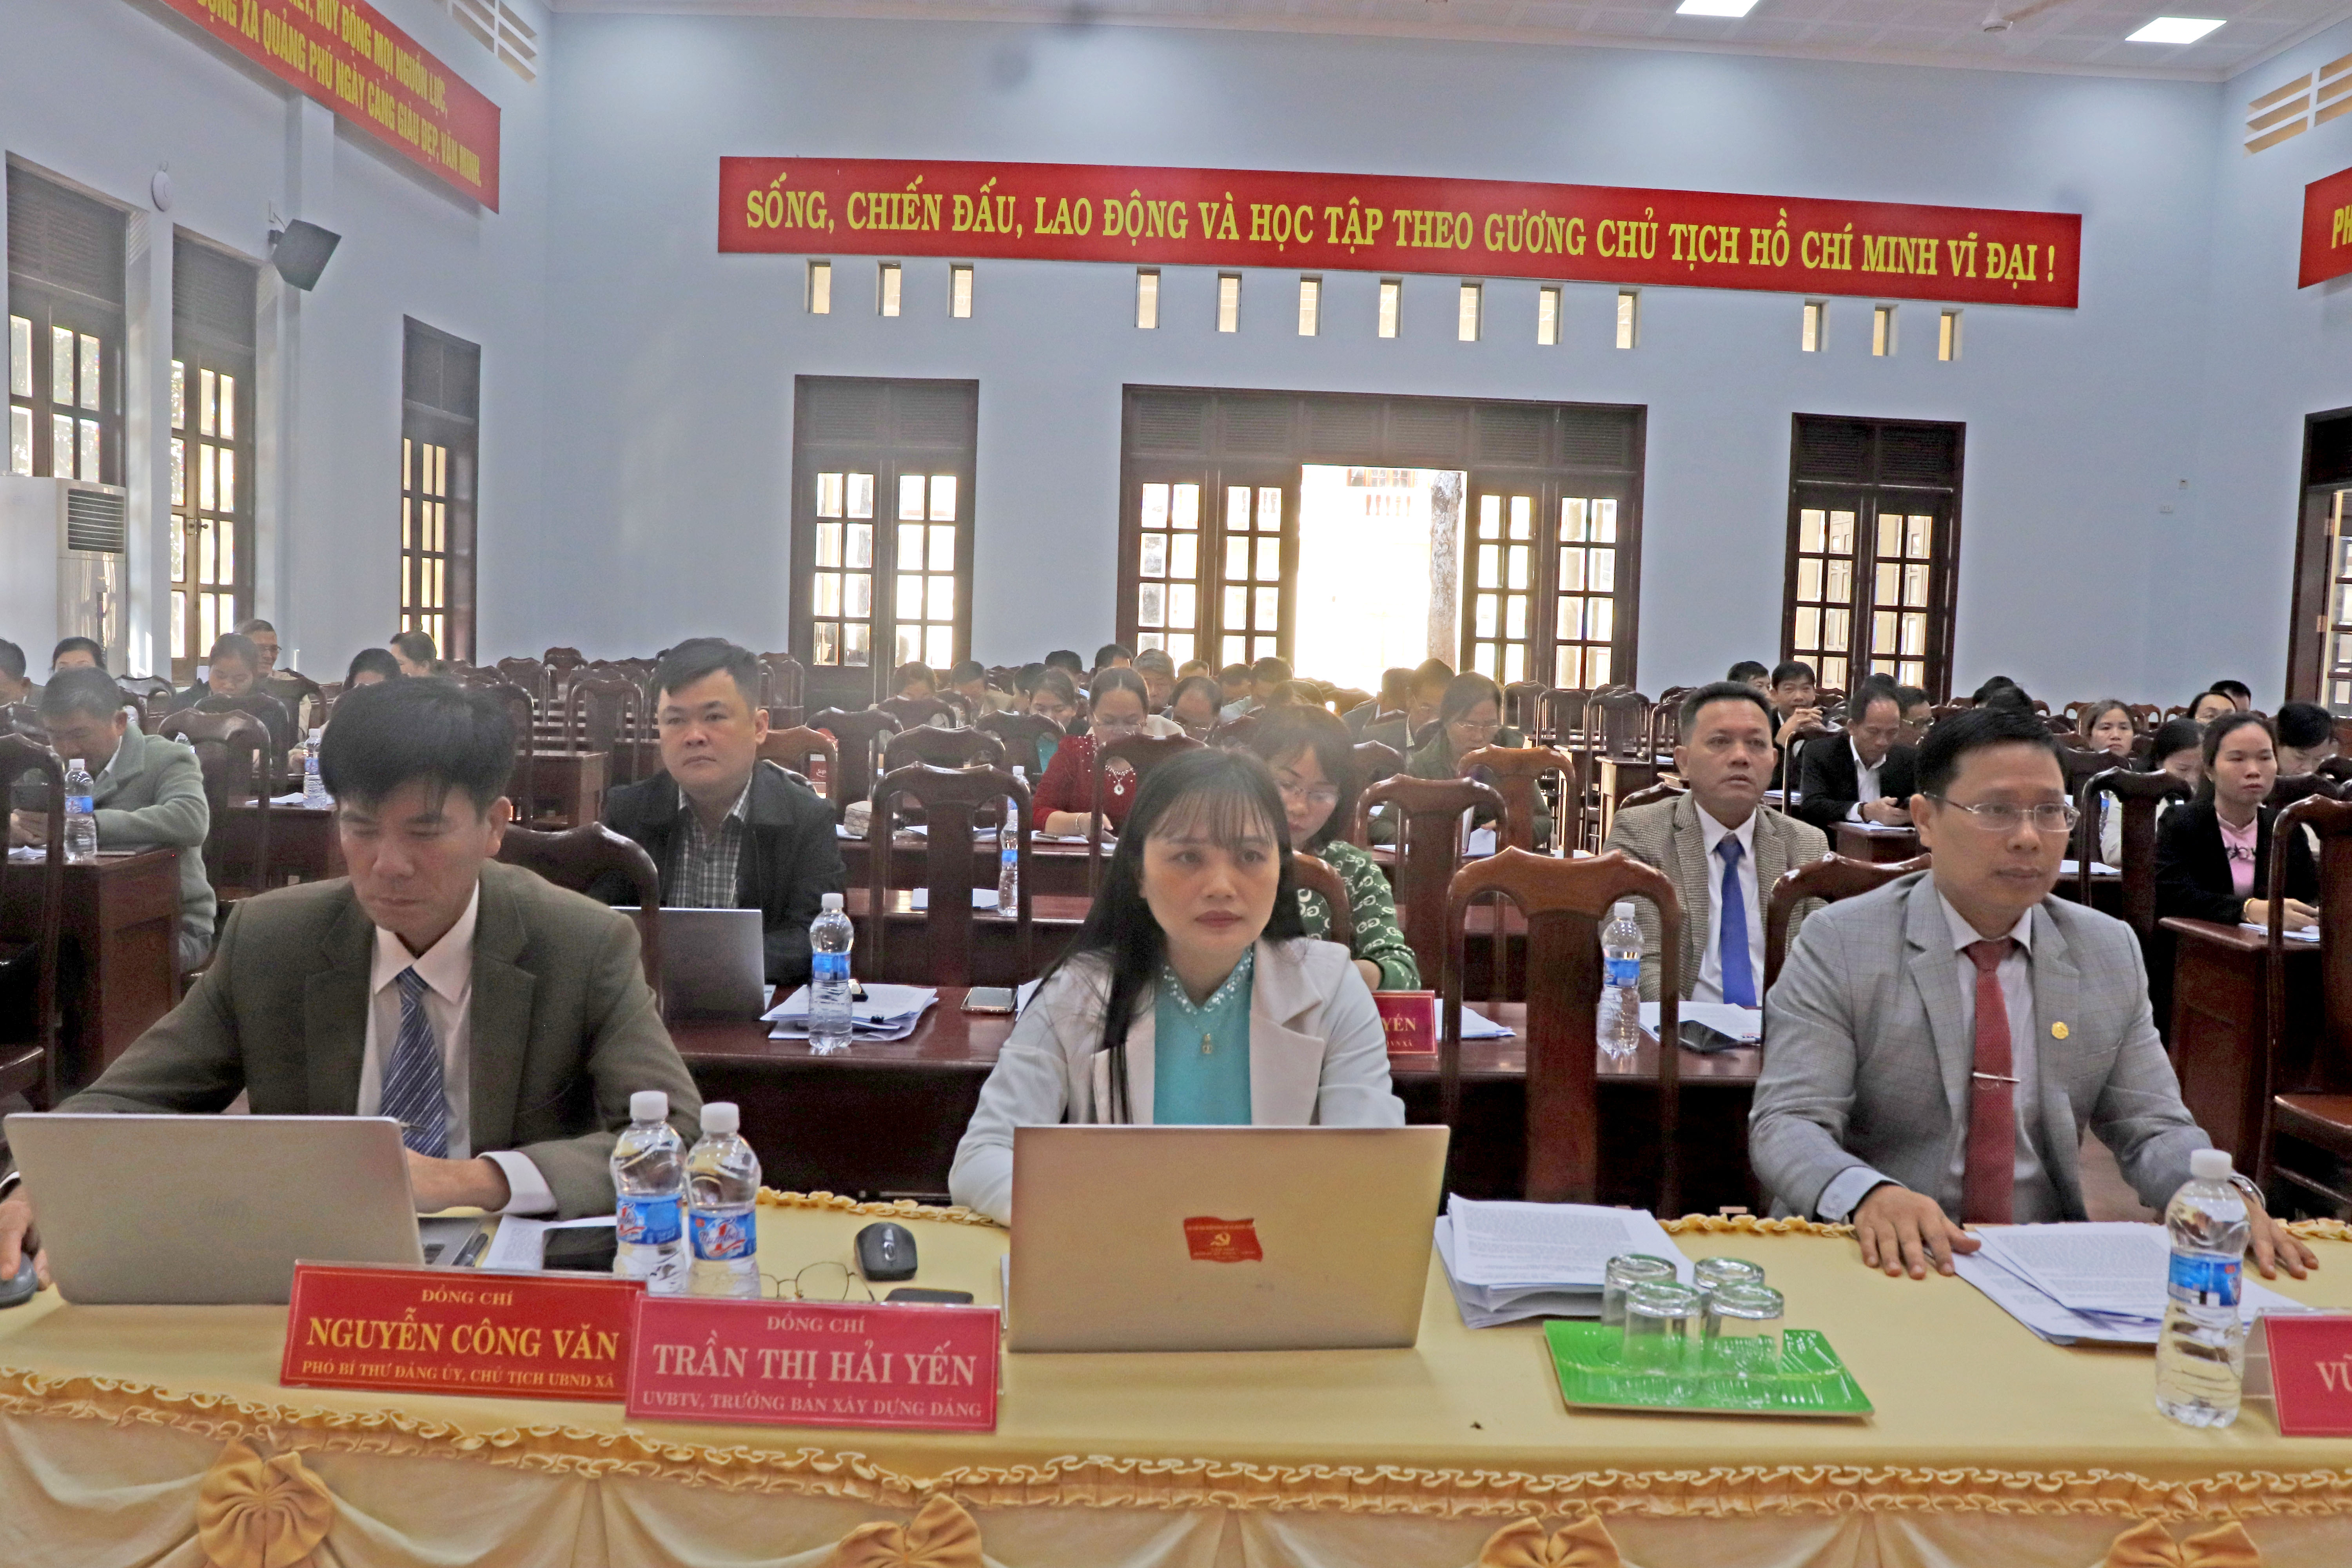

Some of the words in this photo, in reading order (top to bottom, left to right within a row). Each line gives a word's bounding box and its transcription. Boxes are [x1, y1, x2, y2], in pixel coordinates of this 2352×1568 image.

[263, 7, 306, 73] QUẢNG
[309, 40, 333, 90] PHÚ
[336, 58, 365, 111] NGÀY
[368, 77, 395, 131] CÀNG
[397, 100, 419, 147] GIÀU
[341, 4, 371, 60] ĐỘNG
[374, 29, 393, 80] MỌI
[396, 46, 427, 101] NGUỒN
[746, 172, 835, 234] SỐNG,
[847, 175, 943, 230] CHIẾN
[952, 176, 1023, 239] ĐẤU,
[1034, 197, 1093, 236] LAO
[1102, 189, 1189, 247] ĐỘNG
[1198, 191, 1240, 240] VÀ
[1249, 204, 1314, 252] HỌC
[1324, 196, 1384, 254] TẬP
[1392, 209, 1474, 250] THEO
[1485, 208, 1587, 257] GƯƠNG
[1597, 207, 1659, 260] CHỦ
[1669, 223, 1741, 271] TỊCH
[1749, 207, 1790, 267] HỒ
[1801, 223, 1853, 270] CHÍ
[1861, 235, 1939, 275] MINH
[1947, 232, 1978, 278] VĨ
[1986, 242, 2038, 289] ĐẠI
[422, 1283, 474, 1304] ĐỒNG
[479, 1290, 514, 1306] CHÍ
[306, 1307, 444, 1352] NGUYỄN
[451, 1318, 542, 1357] CÔNG
[552, 1323, 620, 1361] VĂN
[829, 1316, 865, 1333] CHÍ
[302, 1359, 334, 1374] PHÓ
[338, 1360, 355, 1375] BÍ
[359, 1363, 392, 1377] THƯ
[394, 1362, 437, 1379] ĐẢNG
[470, 1365, 503, 1383] CHỦ
[508, 1370, 544, 1386] TỊCH
[549, 1373, 591, 1387] UBND
[595, 1372, 615, 1388] XÃ
[652, 1329, 748, 1377] TRẦN
[757, 1348, 818, 1388] THỊ
[828, 1339, 894, 1383] HẢI
[904, 1340, 977, 1387] YẾN
[642, 1391, 705, 1410] UVBTV,
[710, 1390, 785, 1410] TRƯỞNG
[791, 1397, 828, 1412] BAN
[833, 1396, 868, 1413] XÂY
[874, 1398, 924, 1417] DỰNG
